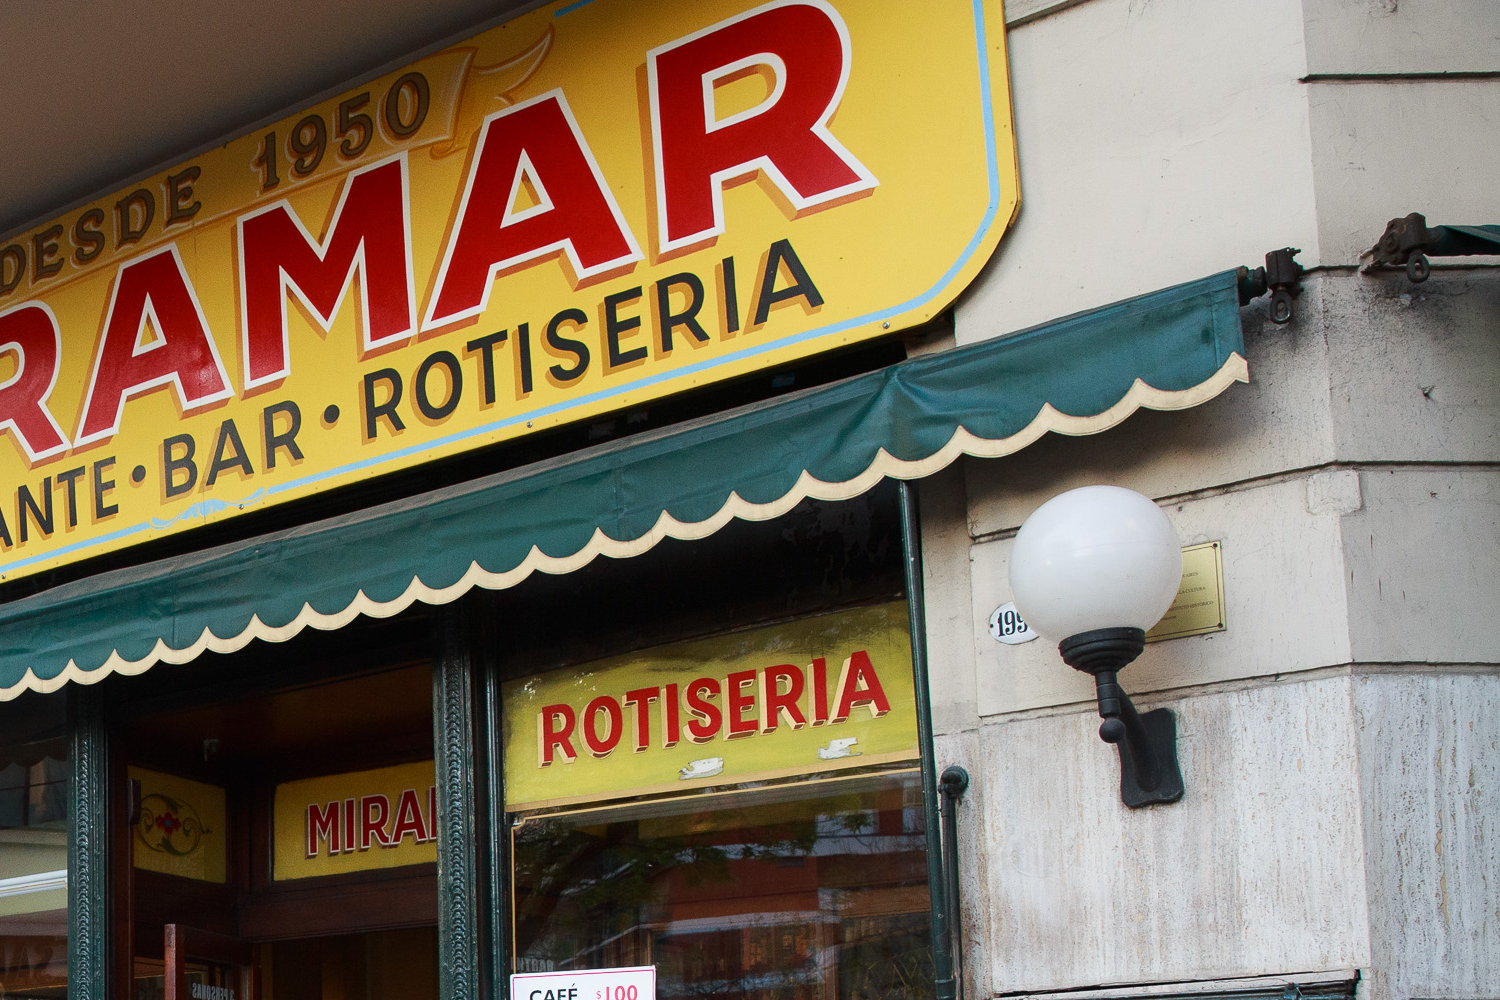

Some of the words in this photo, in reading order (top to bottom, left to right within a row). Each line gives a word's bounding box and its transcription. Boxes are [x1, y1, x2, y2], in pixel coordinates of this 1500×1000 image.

[254, 72, 431, 192] 1950
[162, 401, 304, 500] BAR
[361, 238, 826, 441] ROTISERIA
[537, 650, 891, 769] ROTISERIA
[305, 785, 438, 859] MIRA
